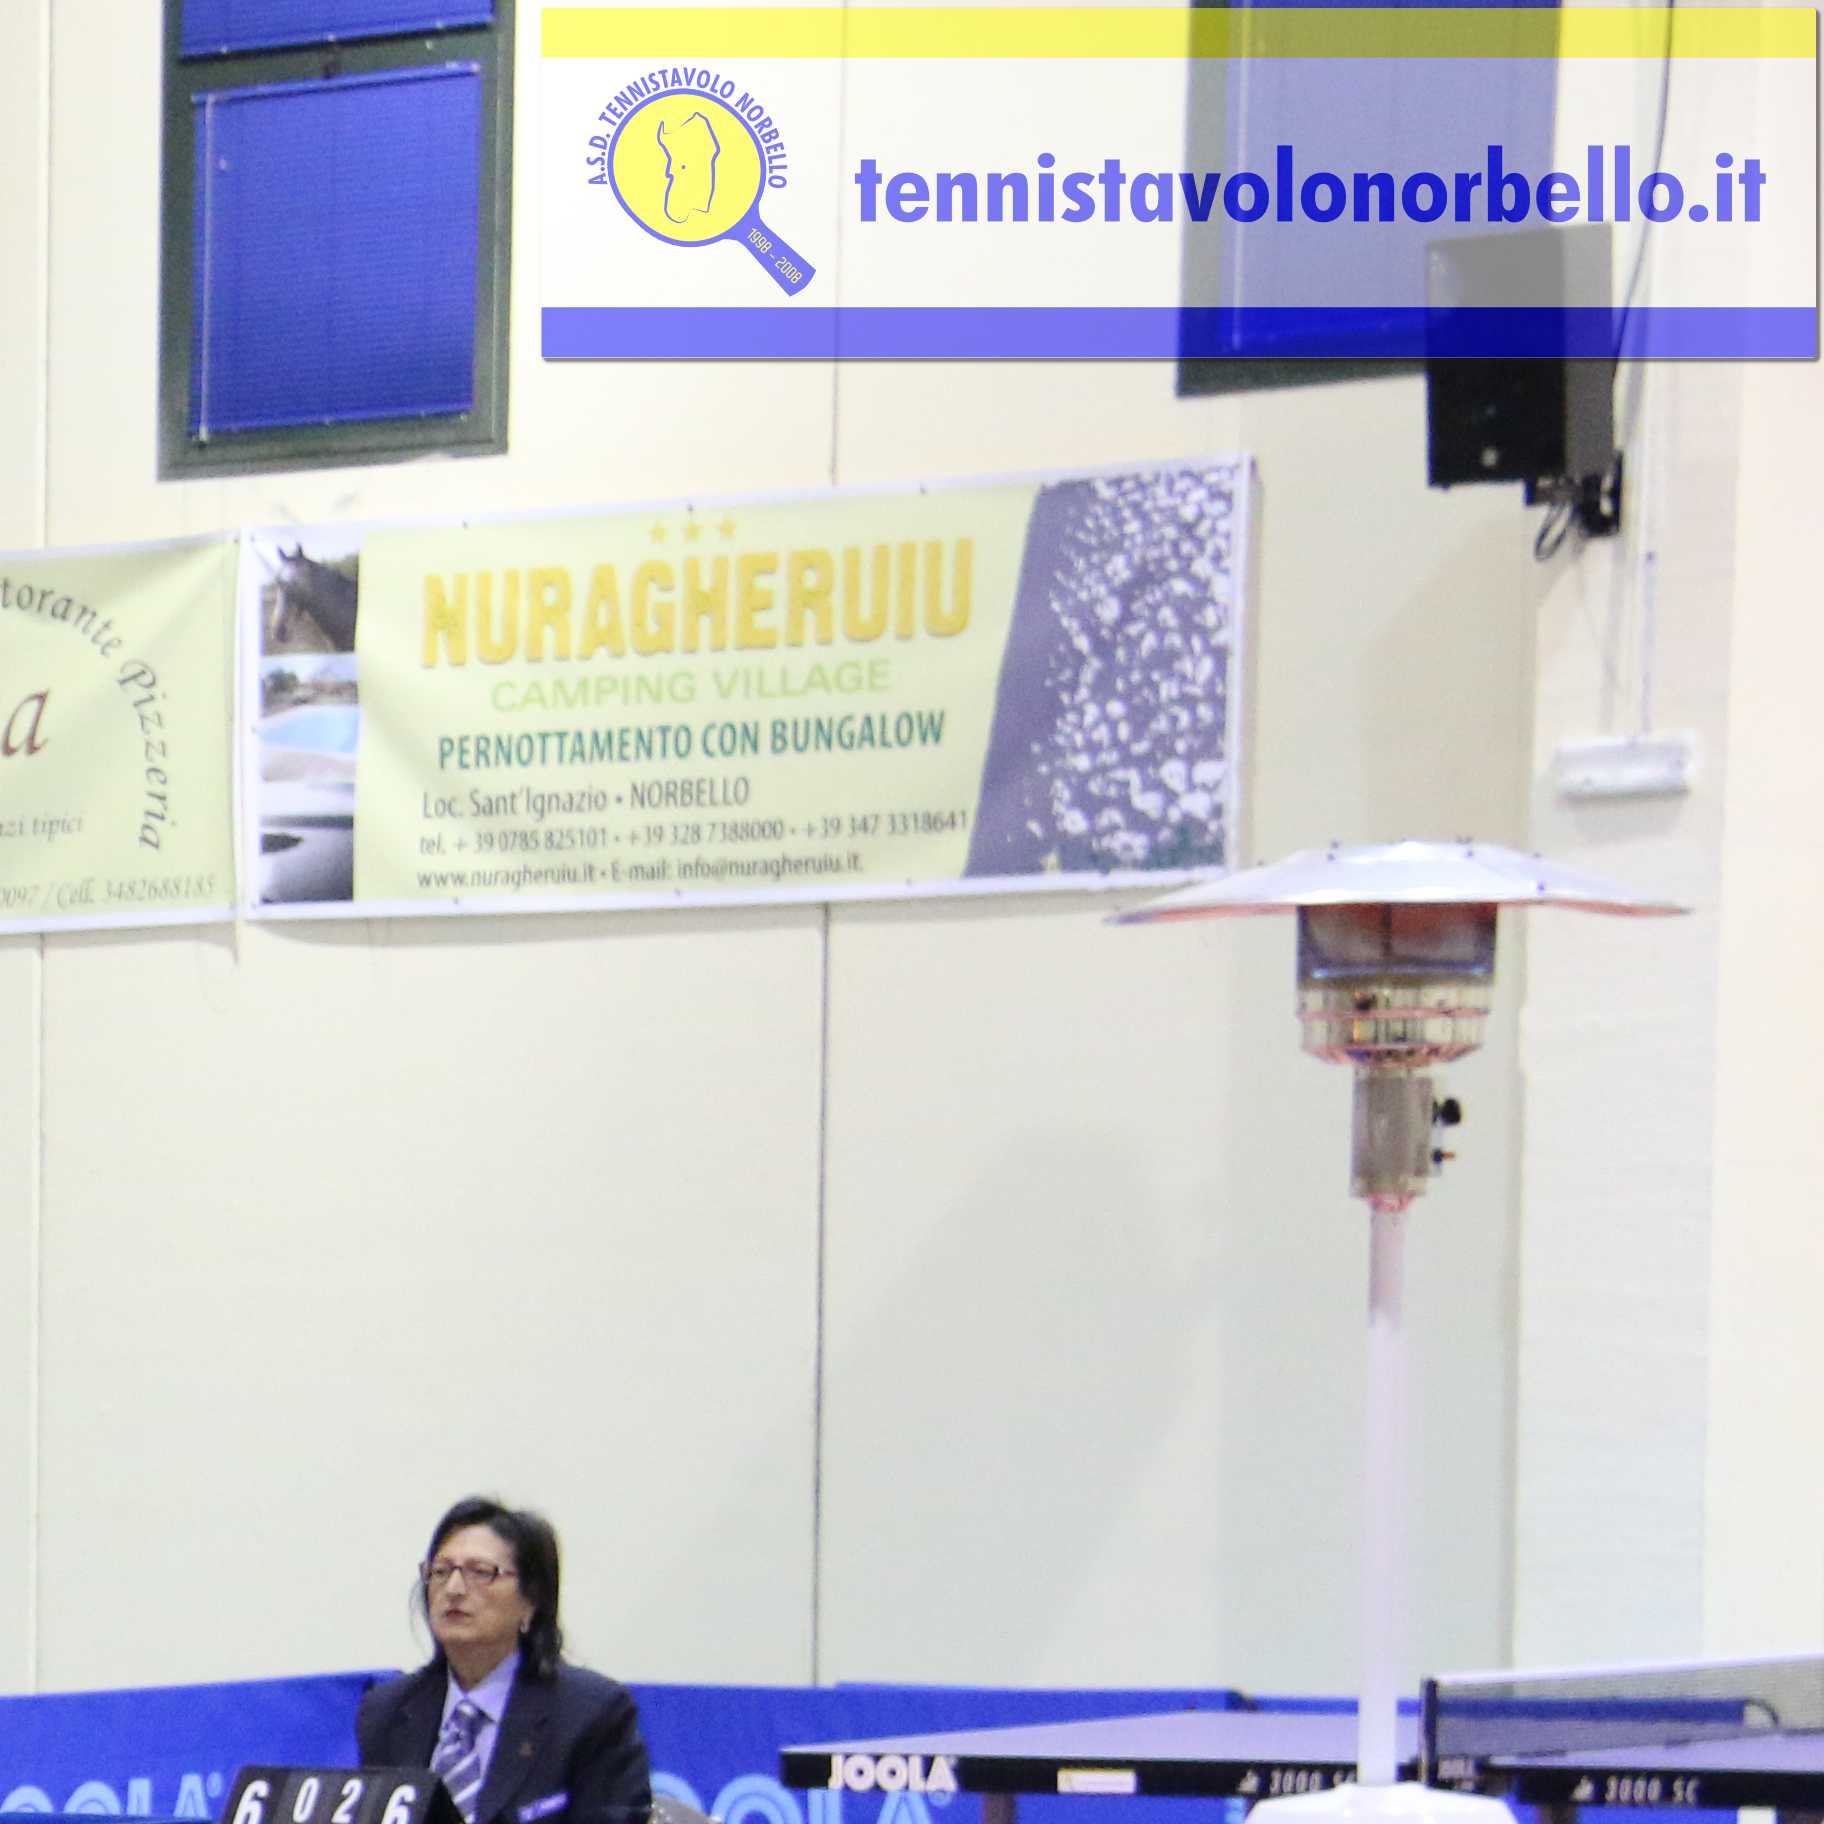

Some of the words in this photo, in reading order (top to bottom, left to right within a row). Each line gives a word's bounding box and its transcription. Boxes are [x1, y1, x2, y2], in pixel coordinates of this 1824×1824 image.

[421, 537, 973, 669] NURAGHERUIU
[490, 669, 696, 714] CAMPING
[714, 659, 891, 701] VILLAGE
[117, 659, 176, 850] Pizzeria
[438, 724, 691, 771] PERNOTTAMENTO
[702, 722, 759, 758] CON
[771, 709, 945, 755] BUNGALOW
[629, 776, 750, 810] NORBELLO
[332, 1779, 363, 1824] 2
